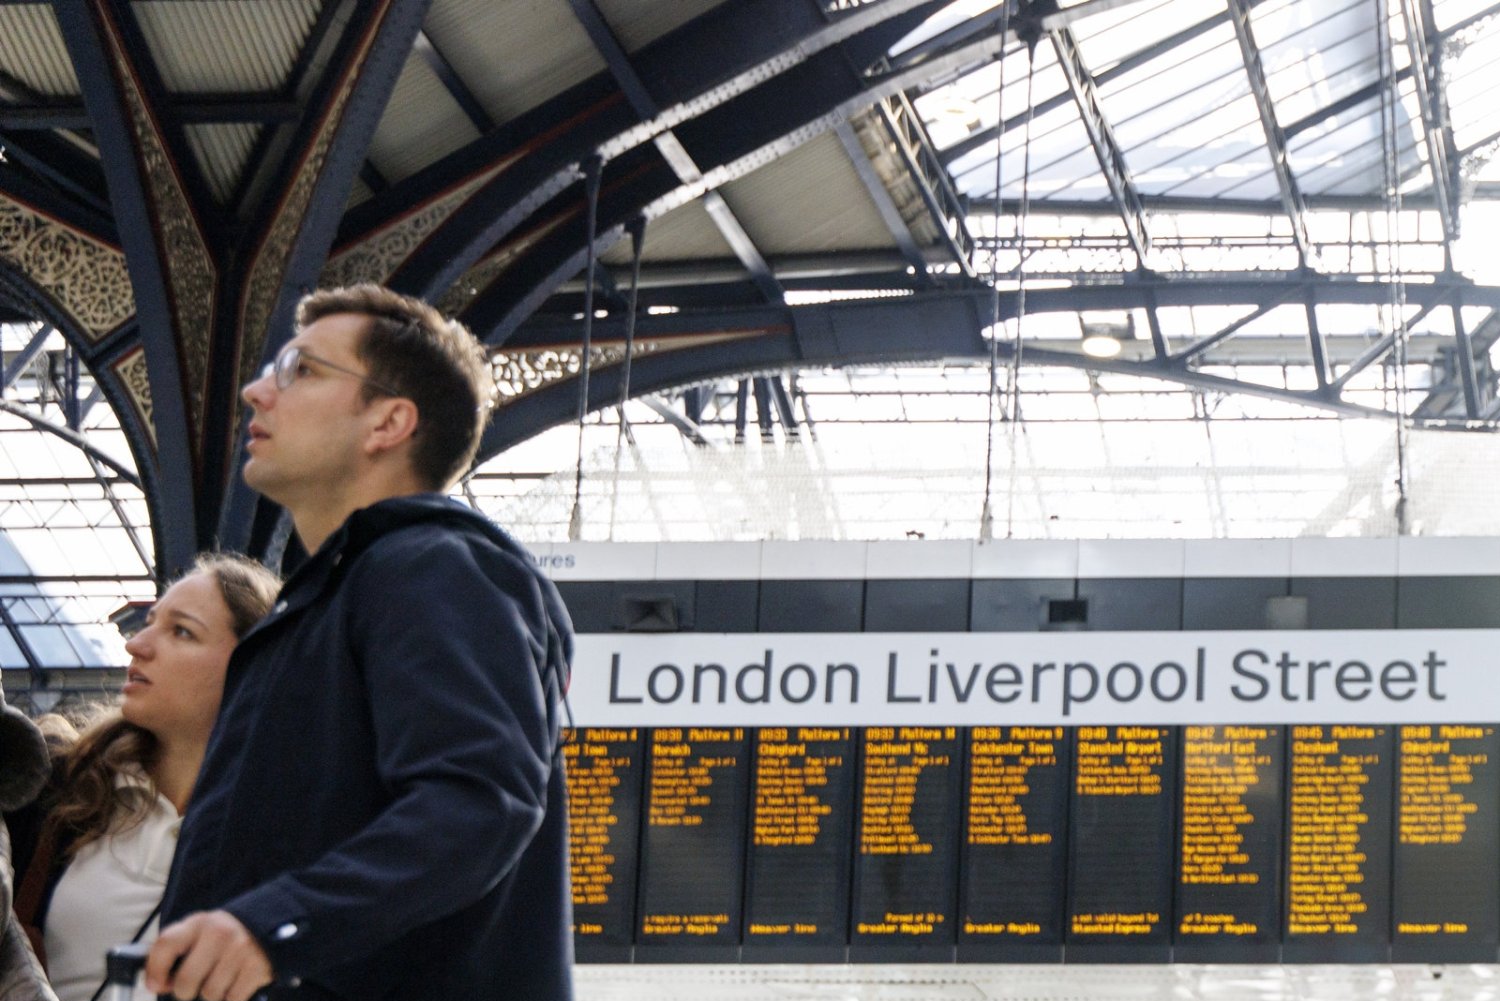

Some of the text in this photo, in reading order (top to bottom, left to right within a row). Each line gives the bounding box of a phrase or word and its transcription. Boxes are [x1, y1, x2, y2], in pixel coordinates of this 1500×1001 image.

[608, 647, 1448, 716] London Liverpool Street
[585, 728, 629, 741] Platform
[688, 728, 731, 741] Platform
[797, 728, 841, 741] Platform
[899, 728, 942, 740] Platform
[1010, 727, 1053, 740] Platform
[1116, 727, 1160, 740] Platform
[1224, 727, 1267, 739] Platform
[1331, 726, 1375, 739] Platform
[1439, 726, 1484, 739] Platform
[652, 743, 692, 756] Norwich
[758, 742, 806, 755] Chingford
[865, 742, 911, 755] Southend
[971, 742, 1054, 755] Colchester Town
[1078, 741, 1162, 754] Stansted Airport
[1185, 741, 1256, 754] Hertford East
[1293, 741, 1339, 754] Cheshunt
